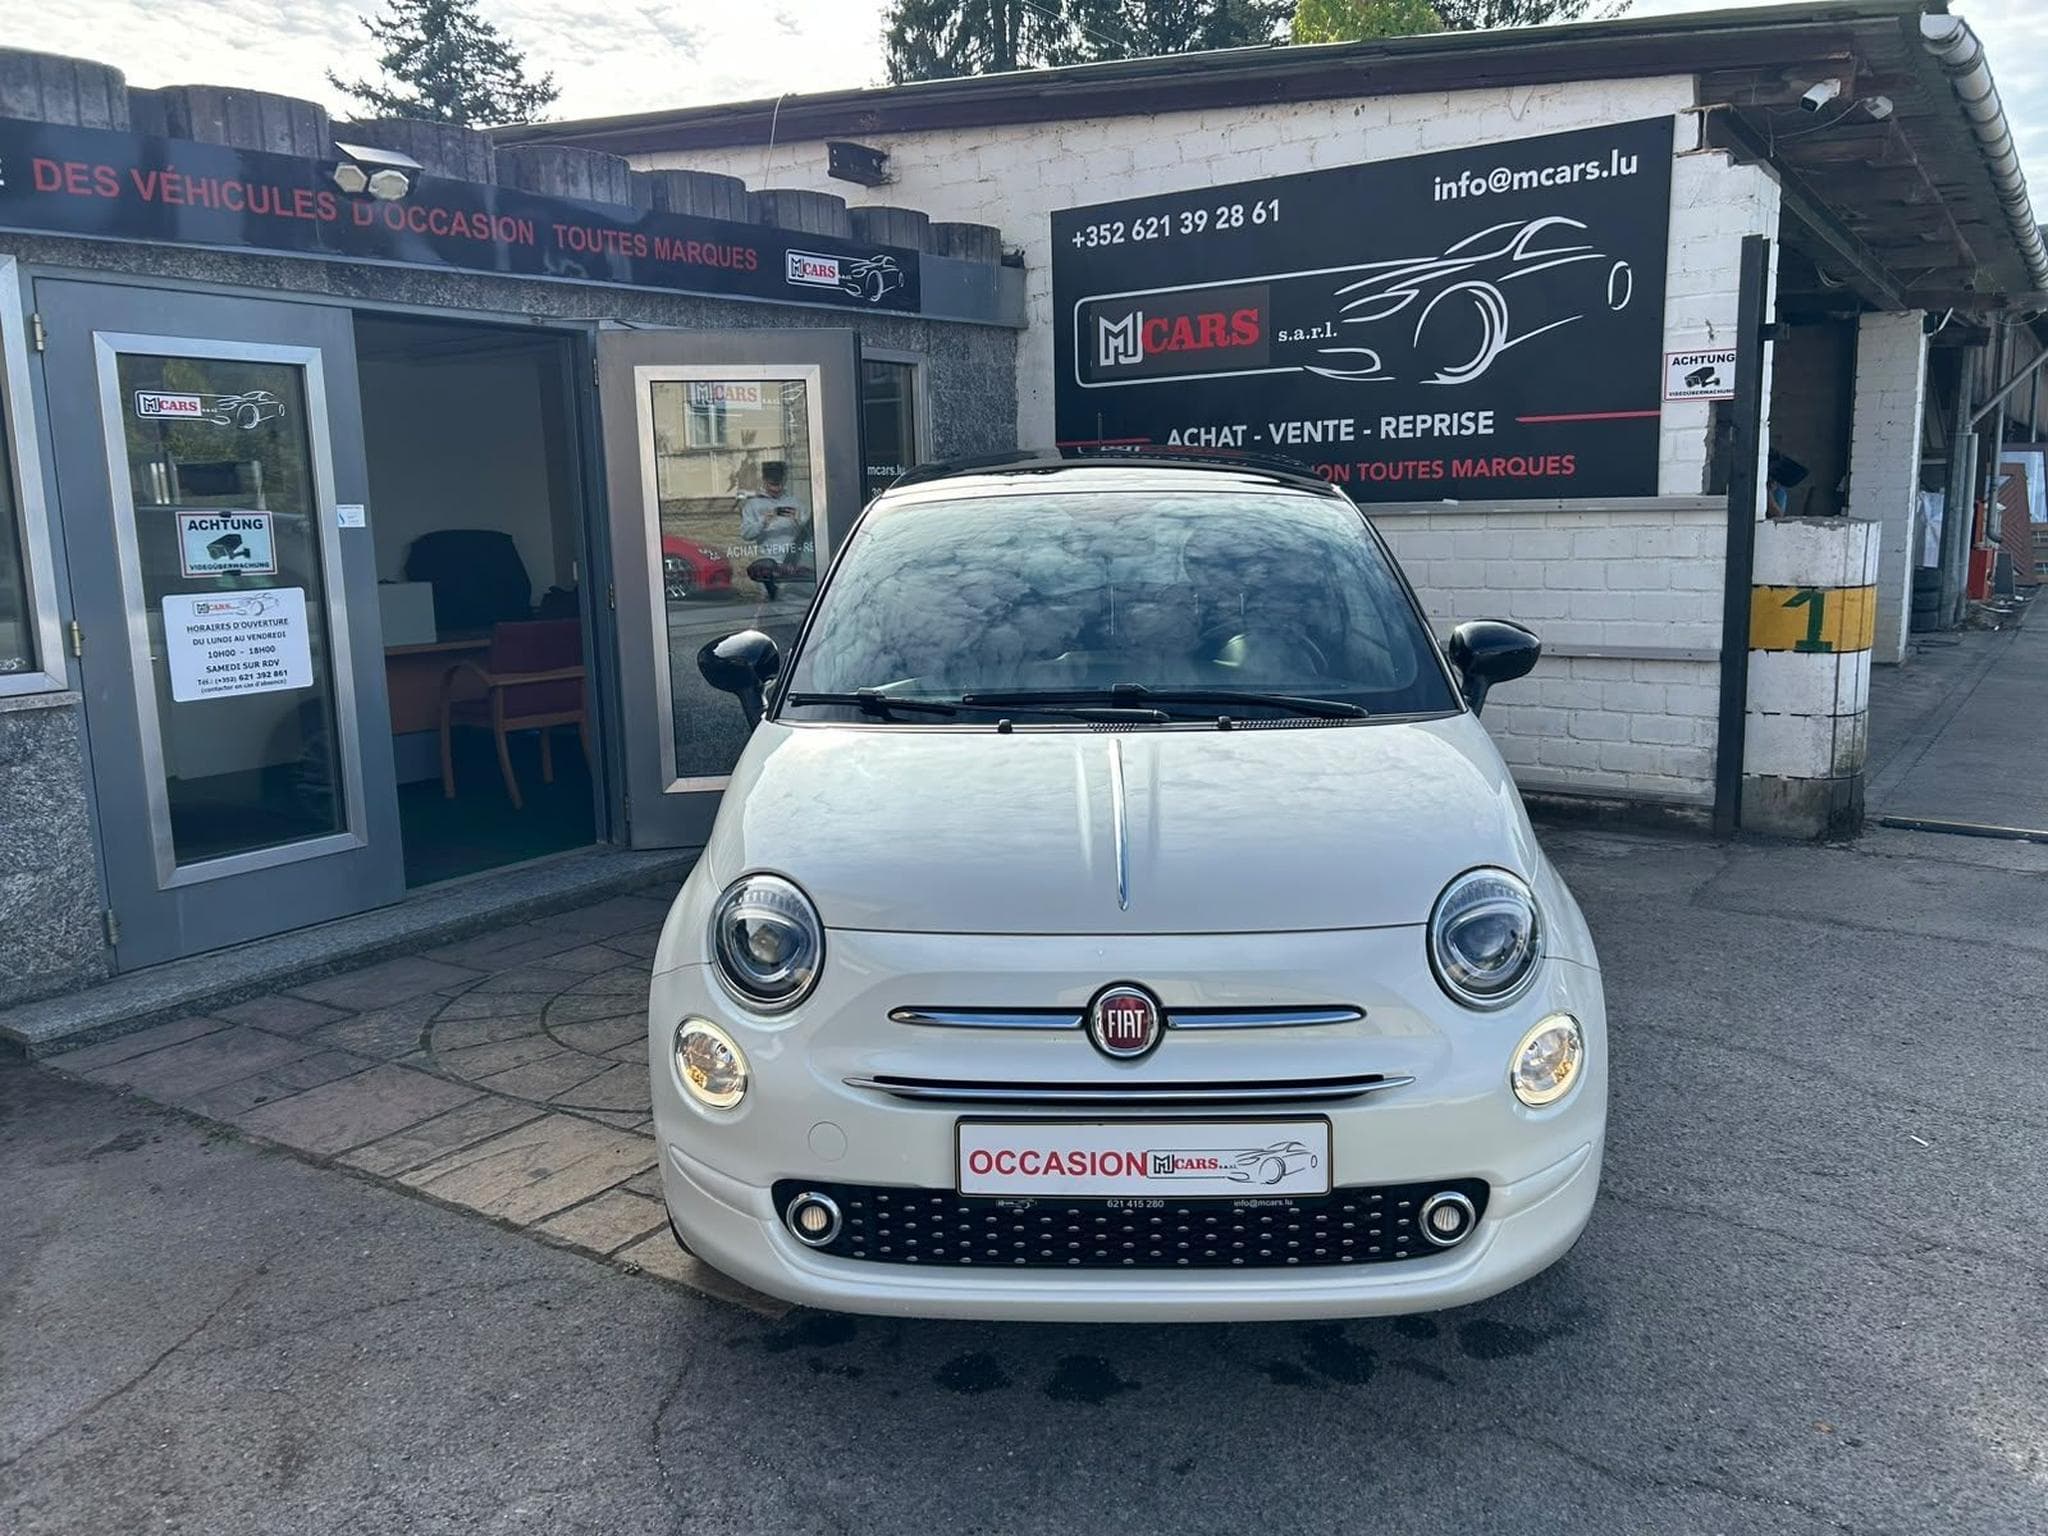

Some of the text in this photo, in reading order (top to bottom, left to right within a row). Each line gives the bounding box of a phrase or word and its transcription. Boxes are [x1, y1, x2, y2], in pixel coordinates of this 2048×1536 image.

[1433, 148, 1639, 202] info@mcars.lu
[31, 157, 120, 198] DES
[130, 164, 338, 222] VÉHICULES
[552, 223, 649, 258] TOUTES
[653, 236, 759, 272] MARQUES
[1071, 198, 1280, 248] +352 621 39 28 61
[1277, 321, 1338, 343] s.a.r.l.
[1671, 352, 1736, 366] ACHTUNG
[1166, 425, 1248, 448] ACHAT
[1268, 418, 1355, 445] VENTE
[1379, 410, 1495, 440] REPRISE
[1356, 459, 1444, 482] TOUTES
[1451, 454, 1576, 479] MARQUES
[187, 518, 264, 531] ACHTUNG
[726, 544, 759, 558] ACHAT
[766, 543, 797, 555] VENTE
[186, 618, 289, 633] HORAIRES D'OUVERTURE
[1780, 590, 1833, 654] 1
[192, 631, 287, 646] DU LUNDI AU VENDREDI
[207, 649, 236, 659] 10H00
[248, 645, 276, 655] 18H00
[205, 658, 280, 673] SAMEDI SUR RDV
[238, 672, 254, 681] 621
[256, 671, 272, 680] 392
[1106, 1008, 1145, 1039] FIAT
[968, 1149, 1148, 1177] OCCASION
[1106, 1200, 1125, 1208] 621
[1127, 1200, 1144, 1208] 415
[1232, 1199, 1294, 1209] info@mcars.lu
